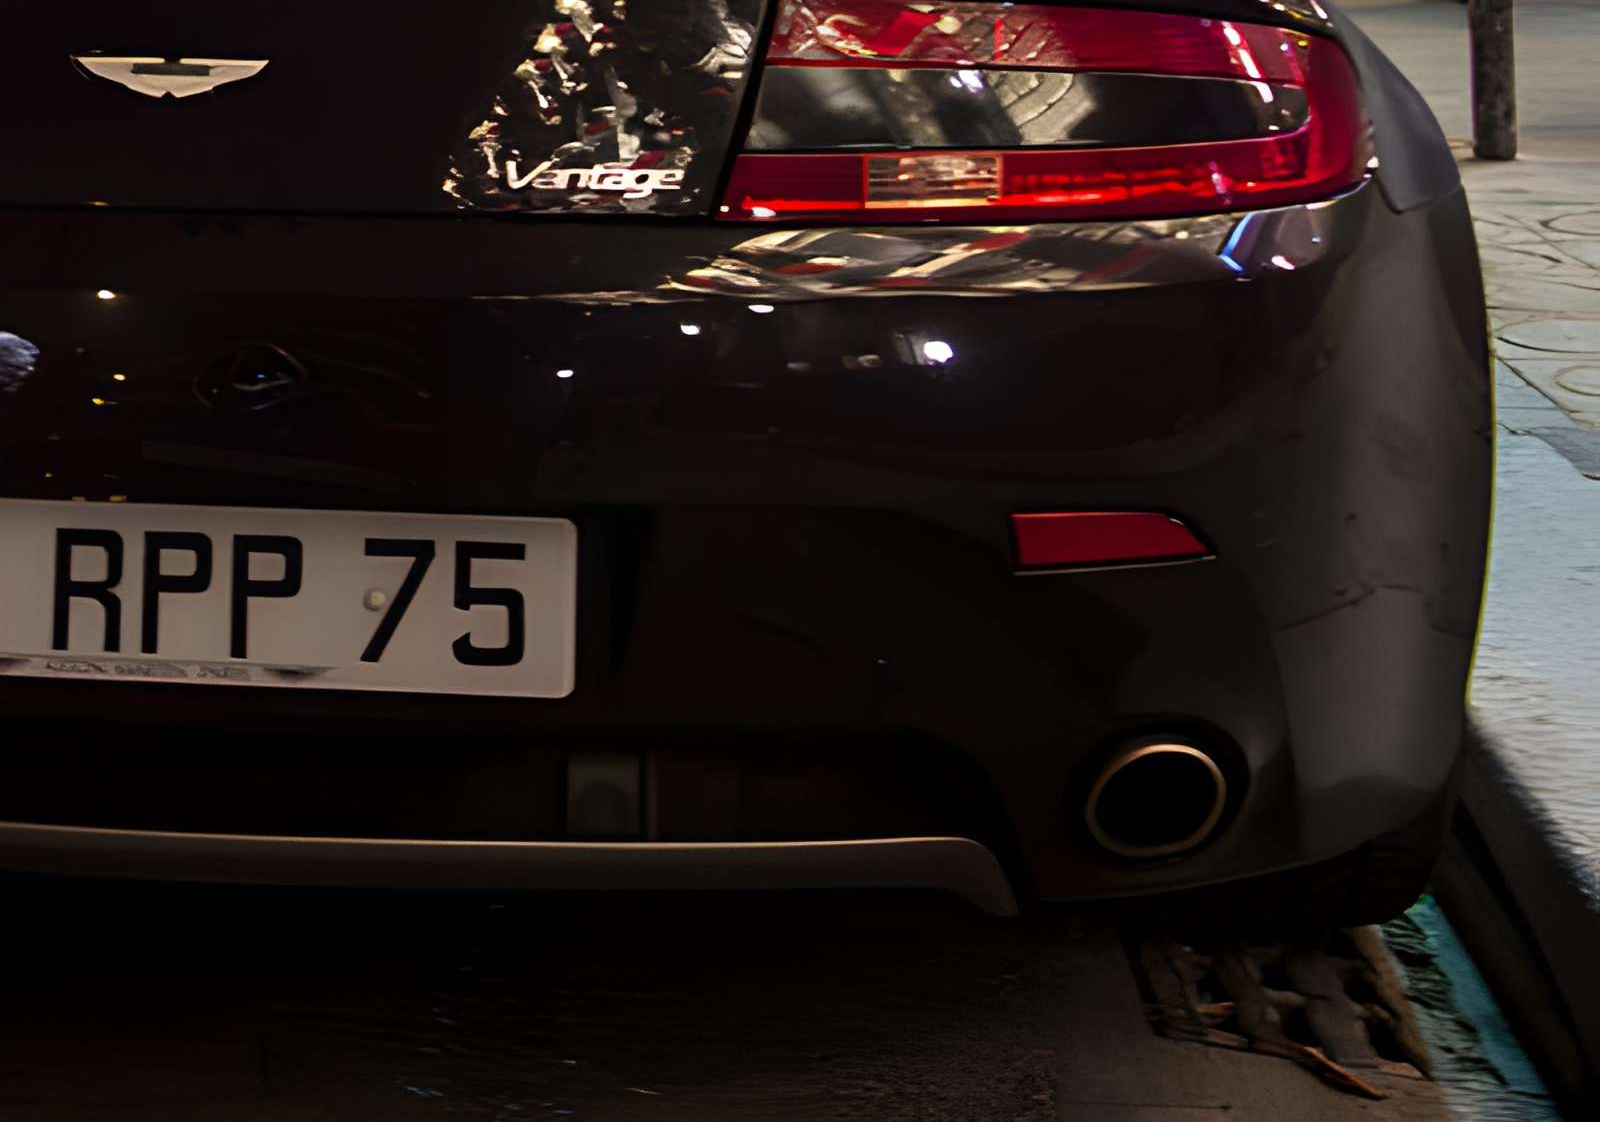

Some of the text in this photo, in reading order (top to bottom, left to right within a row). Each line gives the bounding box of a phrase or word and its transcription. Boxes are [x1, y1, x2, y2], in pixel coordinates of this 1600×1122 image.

[505, 160, 685, 199] Vantage
[52, 527, 304, 659] RPP
[359, 537, 527, 667] 75
